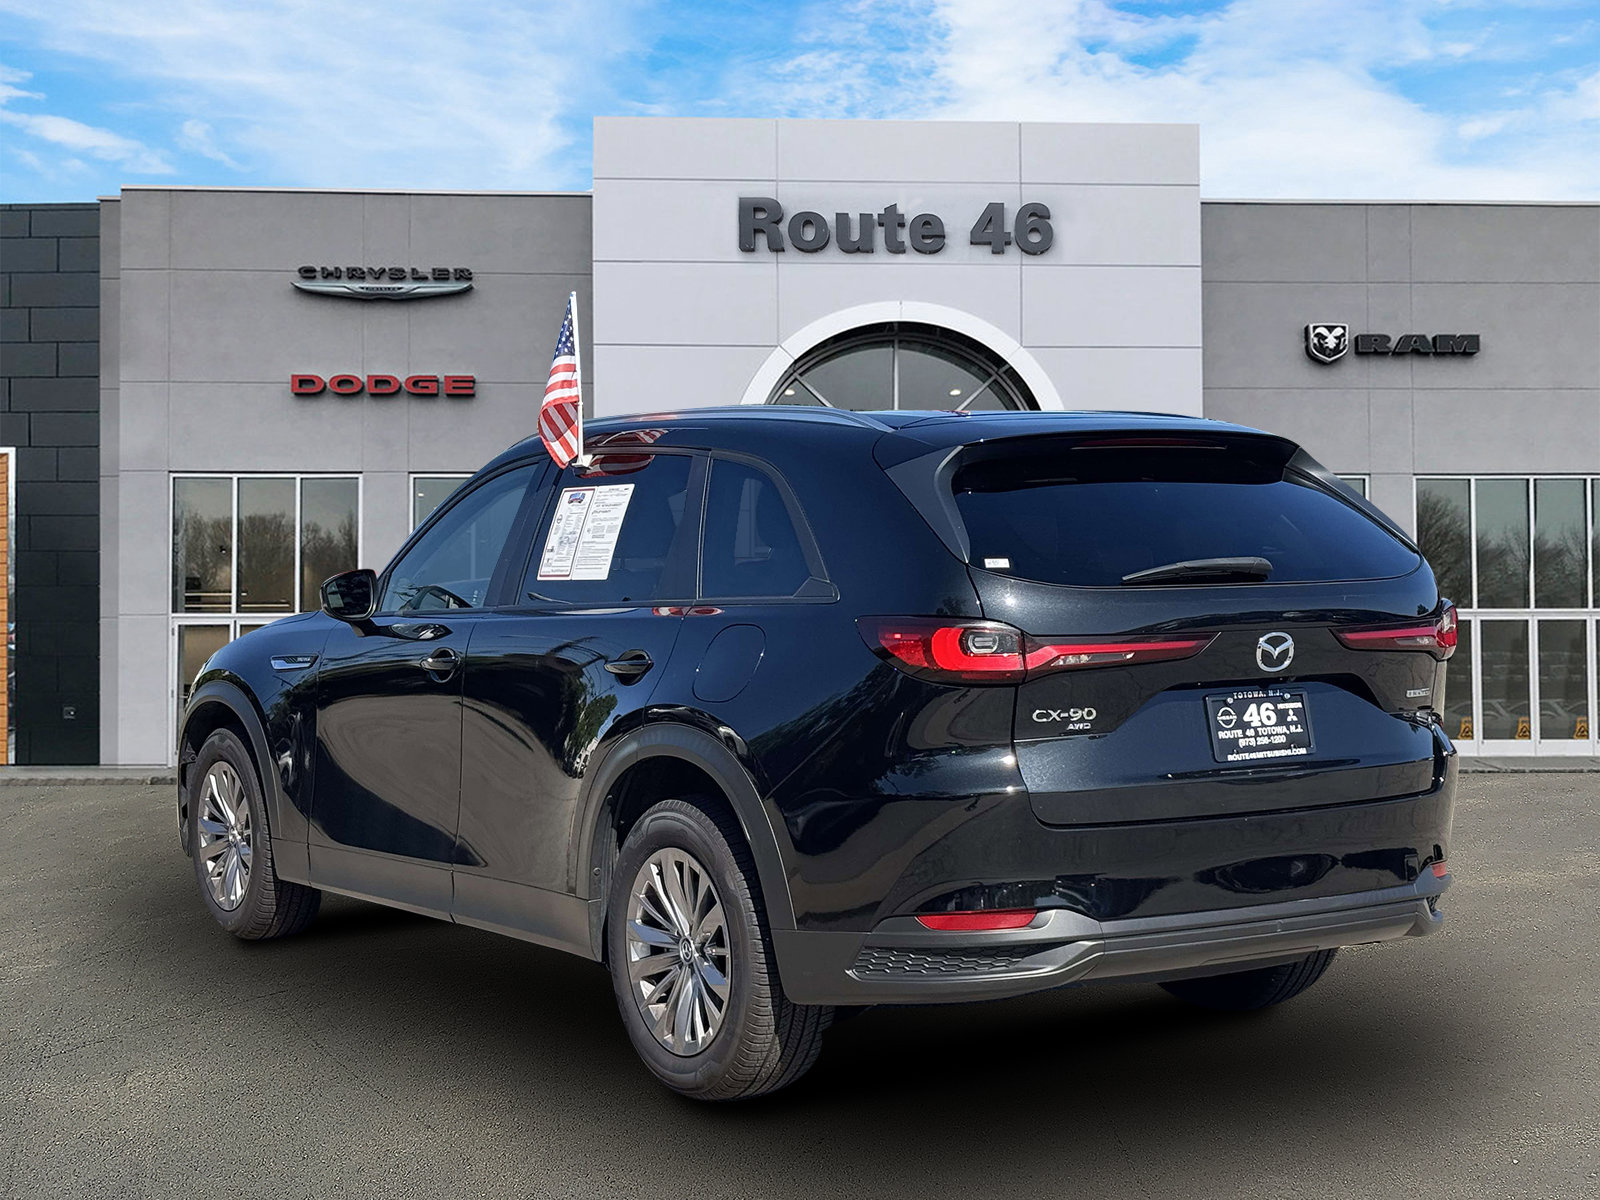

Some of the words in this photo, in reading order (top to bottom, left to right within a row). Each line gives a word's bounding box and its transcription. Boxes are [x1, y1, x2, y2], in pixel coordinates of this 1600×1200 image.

[739, 197, 945, 255] Route
[970, 202, 1053, 255] 46
[298, 265, 473, 280] CHRYSLER
[1354, 334, 1480, 355] RAM
[291, 374, 476, 396] DODGE
[1032, 708, 1097, 722] CX-90
[1243, 702, 1277, 727] 46
[1066, 723, 1091, 731] AWD
[1218, 730, 1243, 739] ROUTE
[1238, 738, 1256, 748] (973)
